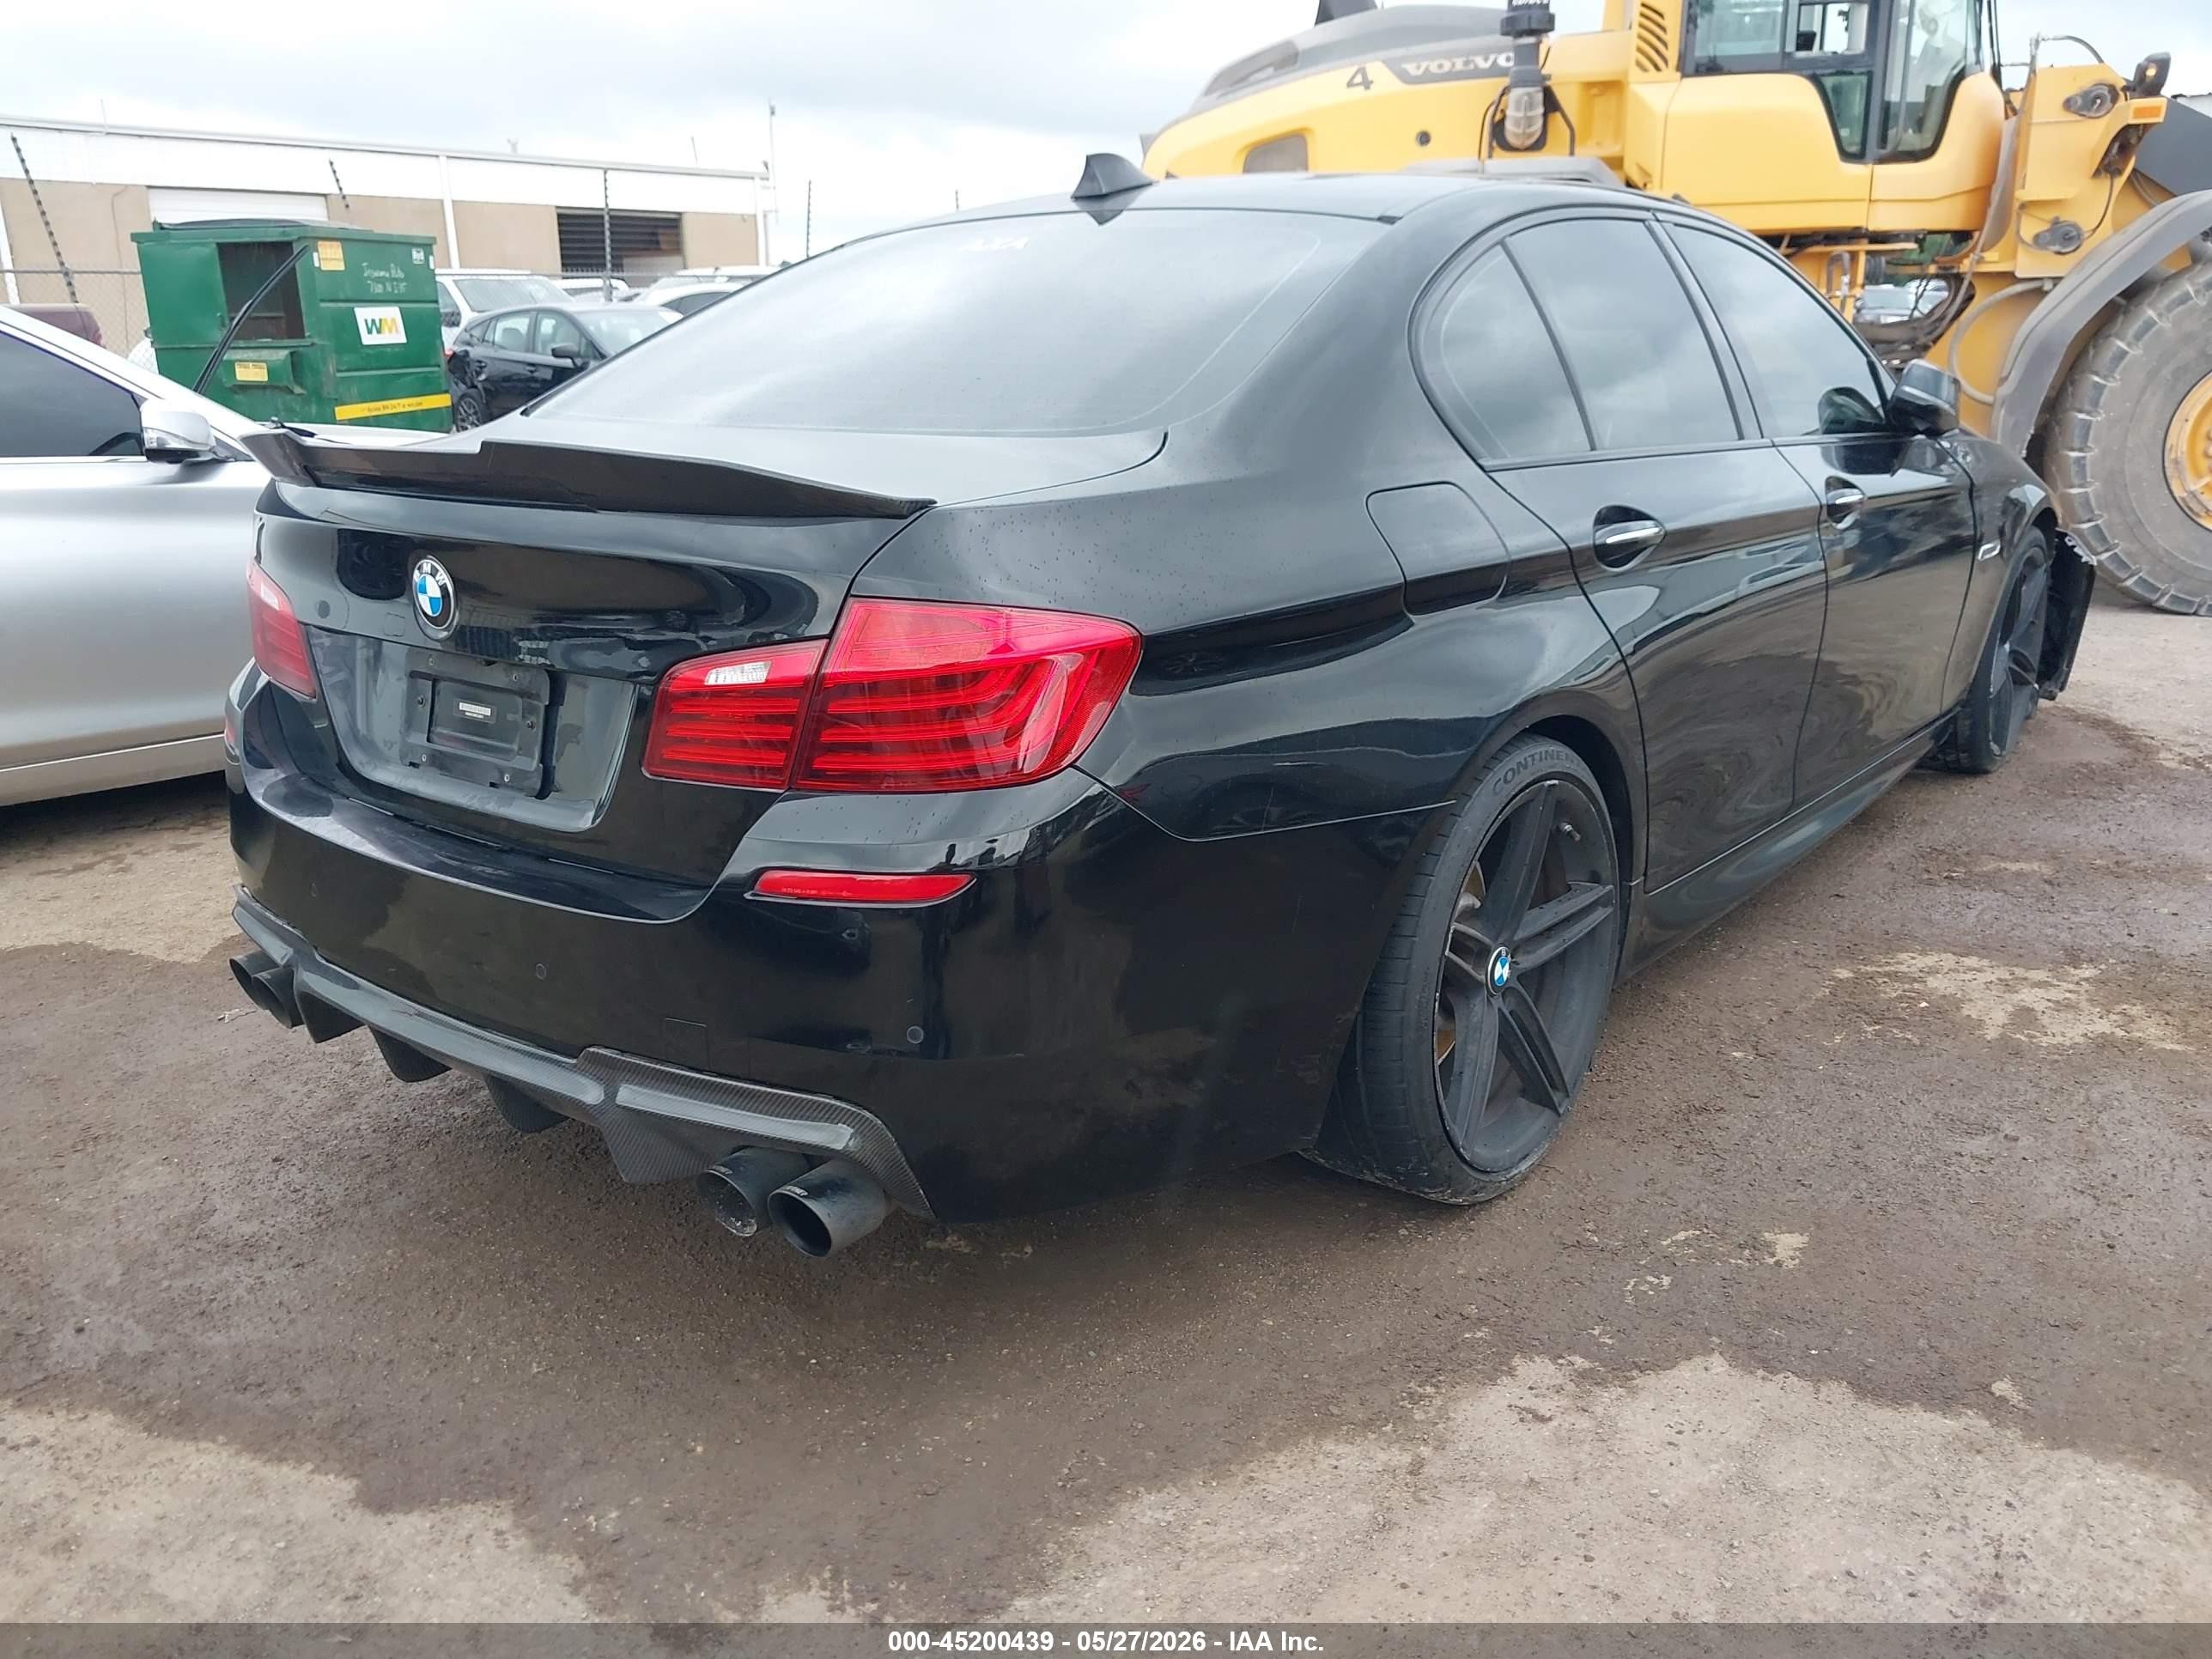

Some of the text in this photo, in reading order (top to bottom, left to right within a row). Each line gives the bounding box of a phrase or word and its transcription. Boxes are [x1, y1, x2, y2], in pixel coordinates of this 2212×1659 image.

[1401, 52, 1515, 76] VOLVO
[1346, 66, 1374, 90] 4
[363, 317, 399, 335] WM
